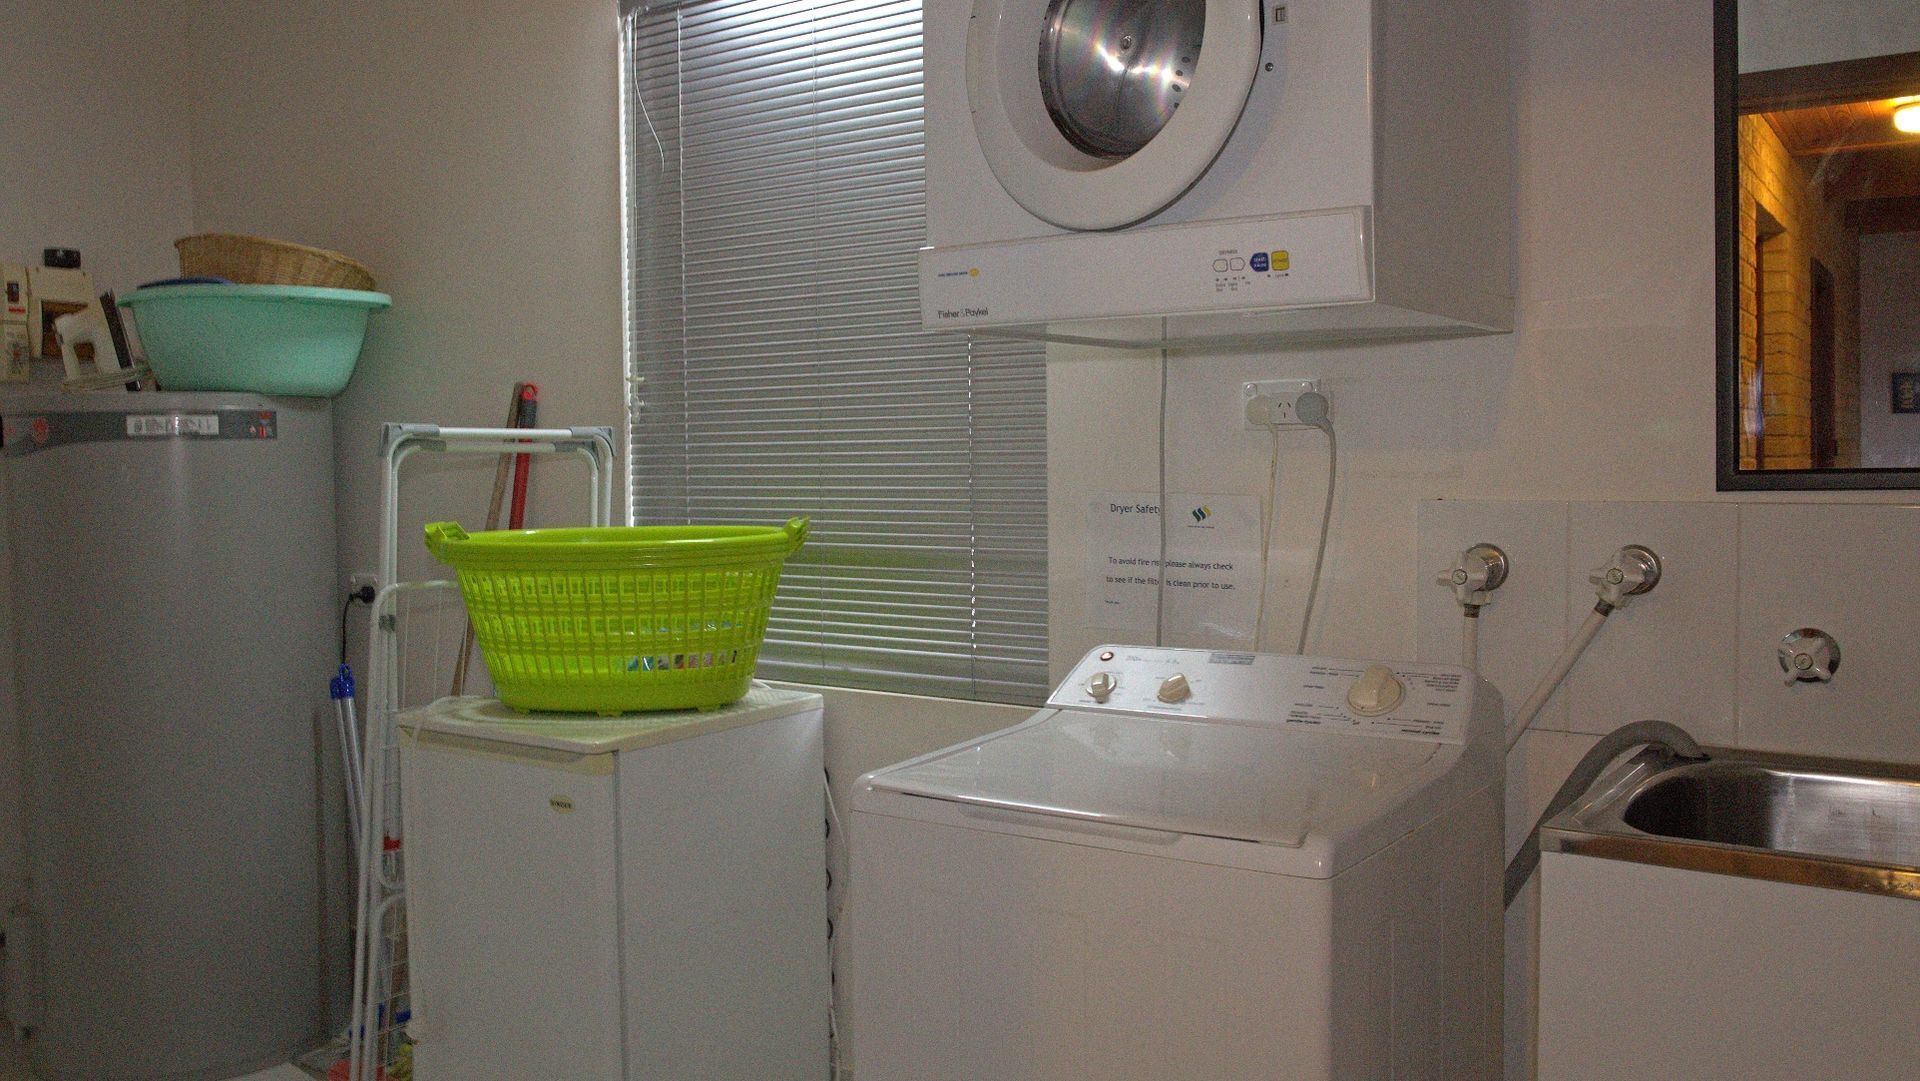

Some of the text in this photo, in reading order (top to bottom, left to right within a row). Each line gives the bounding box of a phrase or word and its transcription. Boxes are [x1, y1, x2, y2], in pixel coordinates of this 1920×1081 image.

[938, 310, 960, 319] Fisher
[965, 307, 989, 318] Paykel
[1110, 503, 1134, 515] Dryer
[1109, 556, 1118, 565] To
[1118, 557, 1137, 566] avoid
[1137, 558, 1150, 566] fire
[1165, 560, 1187, 569] please
[1188, 561, 1212, 571] always
[1212, 562, 1234, 571] check
[1127, 576, 1134, 584] if
[1134, 576, 1146, 585] the
[1172, 579, 1192, 587] clean
[1192, 581, 1210, 590] prior
